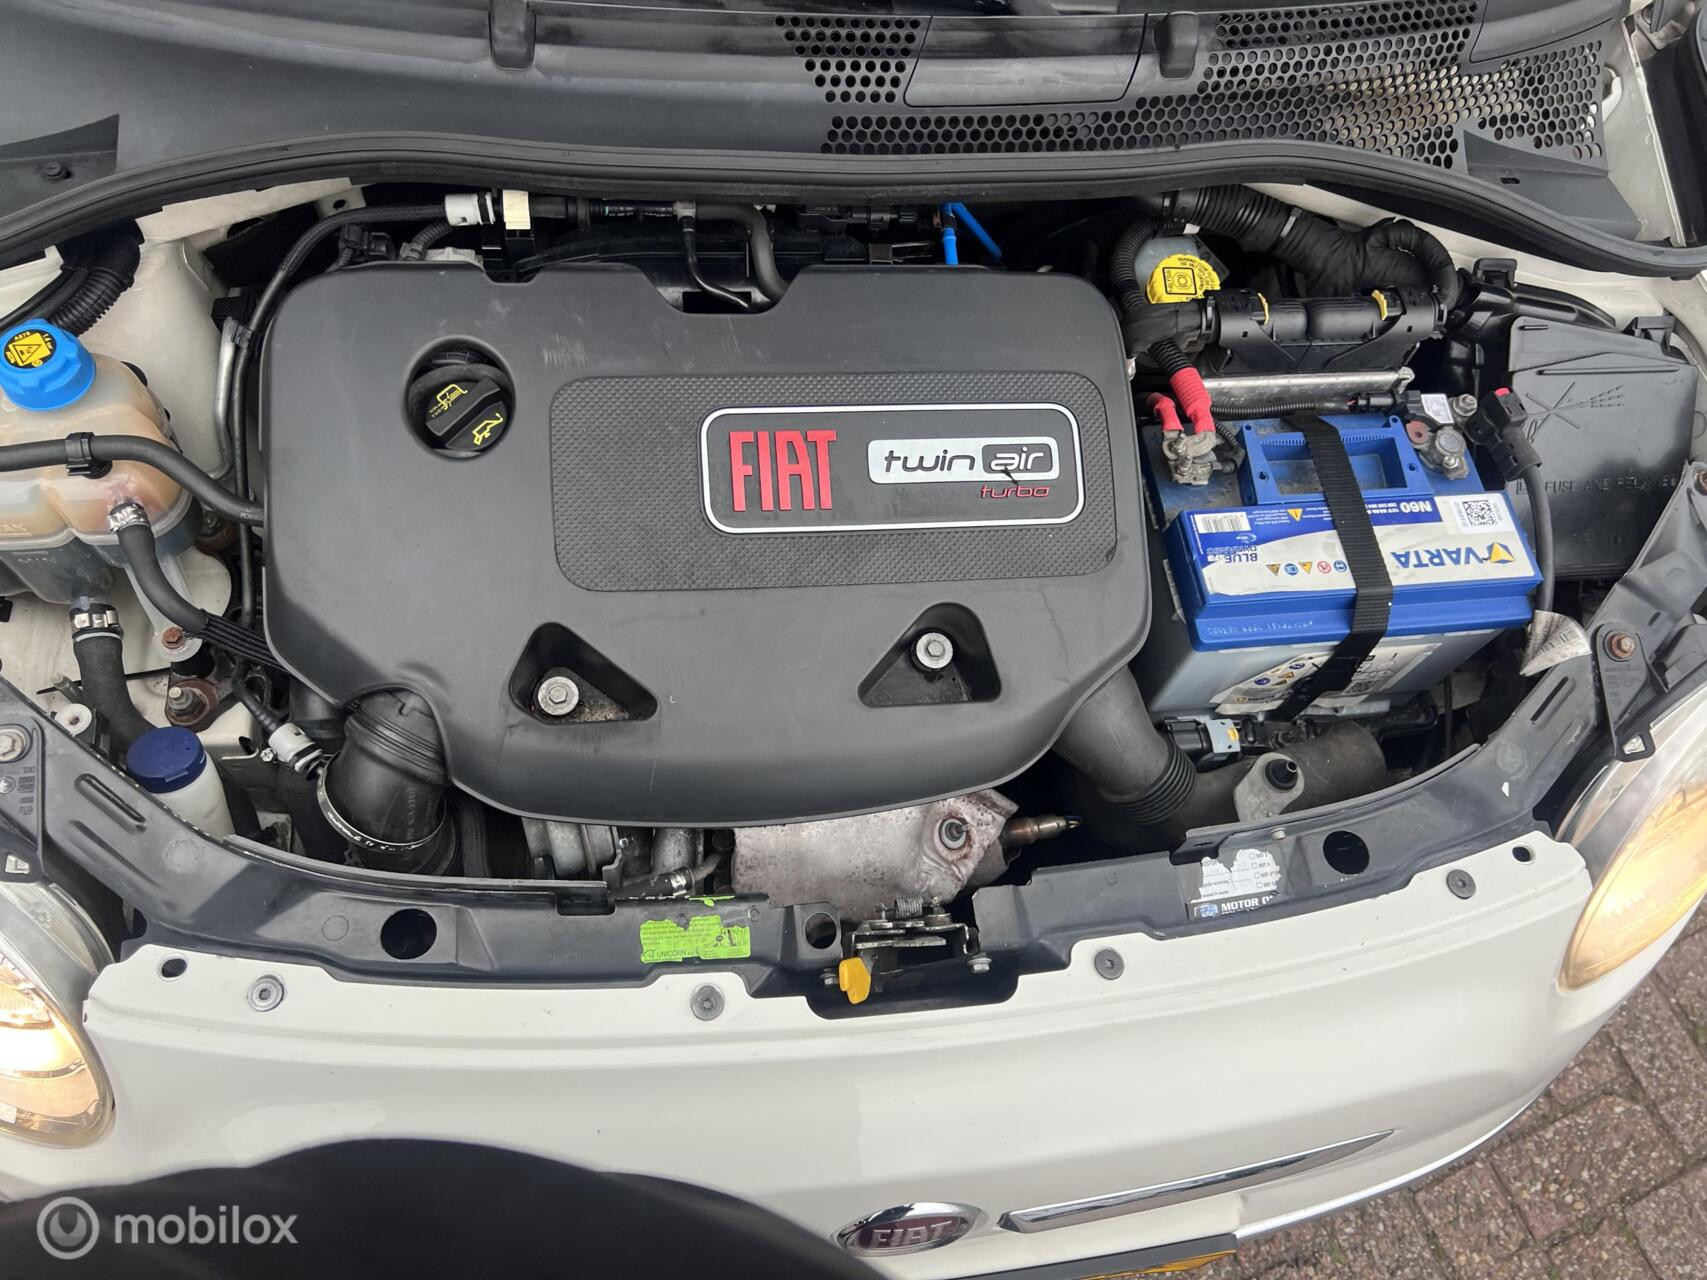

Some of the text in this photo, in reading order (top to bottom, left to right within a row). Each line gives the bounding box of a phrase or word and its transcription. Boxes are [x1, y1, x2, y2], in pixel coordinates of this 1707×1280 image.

[884, 446, 1045, 474] twin air
[728, 430, 838, 512] FIAT
[980, 484, 1051, 499] turbo
[1544, 479, 1577, 494] FUSE
[1584, 478, 1611, 492] AND
[1399, 500, 1433, 514] N60
[1206, 545, 1258, 556] DYNAMIC
[1390, 546, 1485, 569] VARTA
[1224, 552, 1259, 565] BLUE
[1221, 898, 1259, 912] MOTOR
[656, 949, 687, 958] UNICORN
[868, 1220, 953, 1248] FIAT
